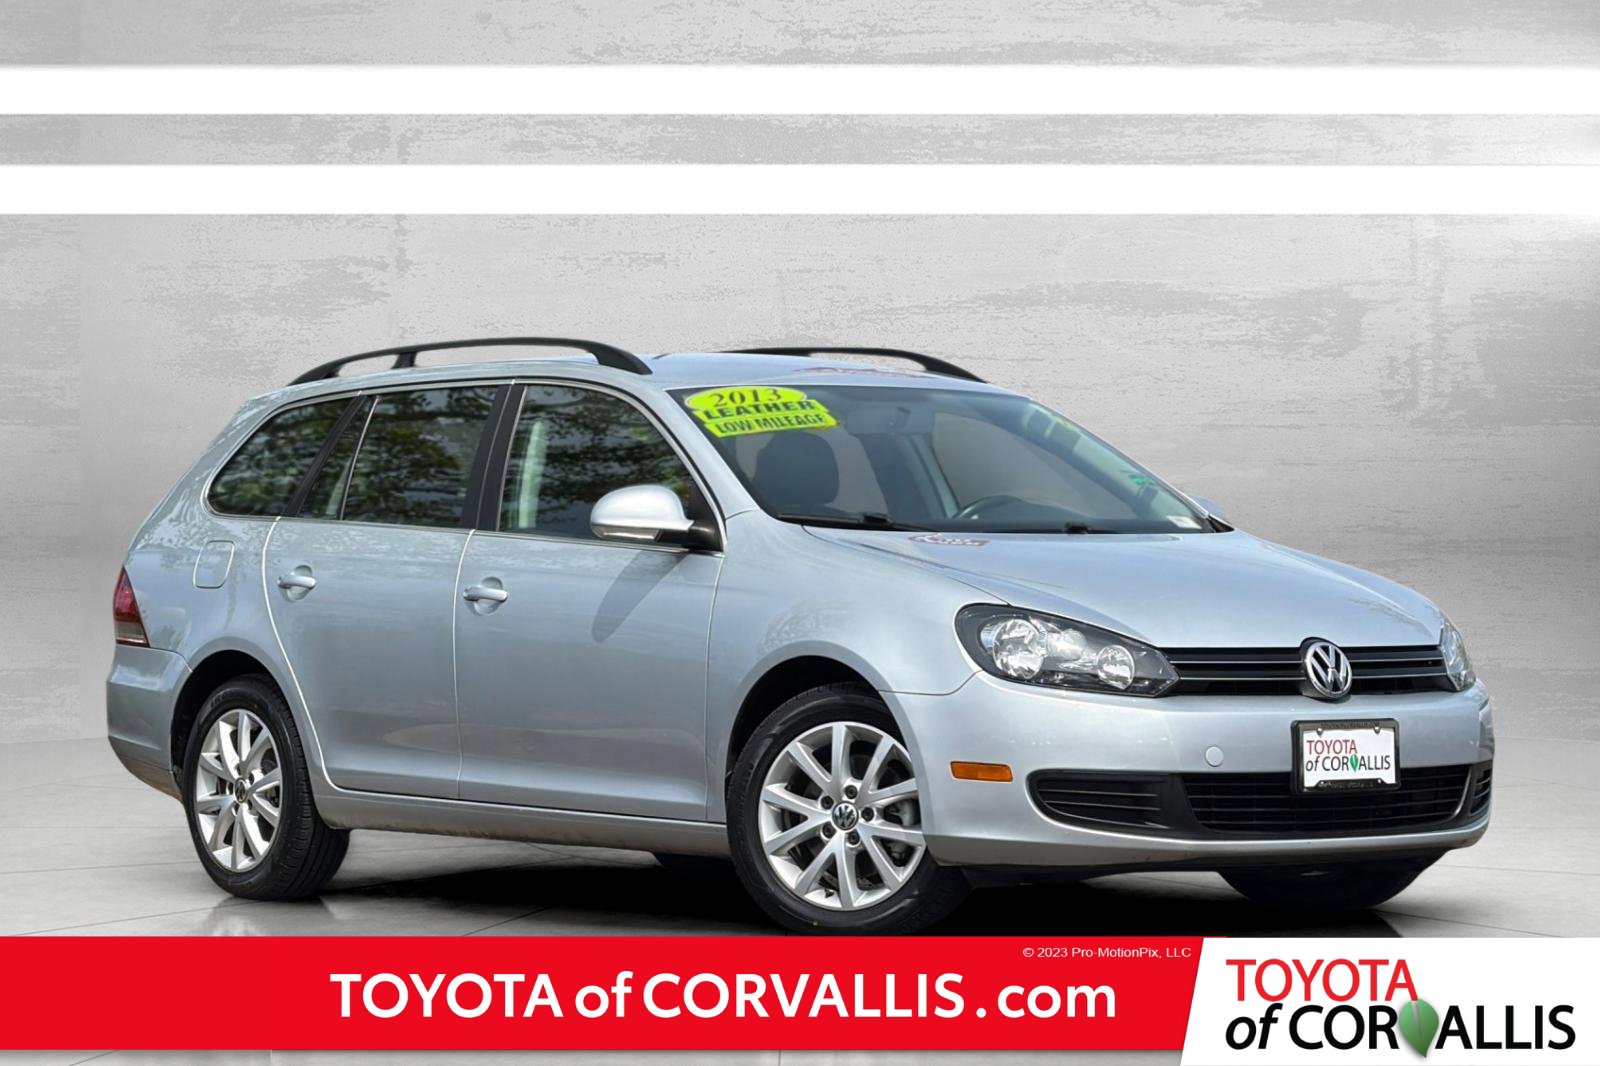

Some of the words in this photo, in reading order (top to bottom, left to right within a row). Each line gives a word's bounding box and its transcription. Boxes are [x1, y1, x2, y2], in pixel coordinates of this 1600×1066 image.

[708, 388, 782, 408] 2013
[703, 400, 817, 420] LEATHER
[714, 421, 751, 434] LOW
[755, 413, 826, 430] MILEAGE
[1306, 739, 1358, 755] TOYOTA
[1305, 755, 1321, 772] of
